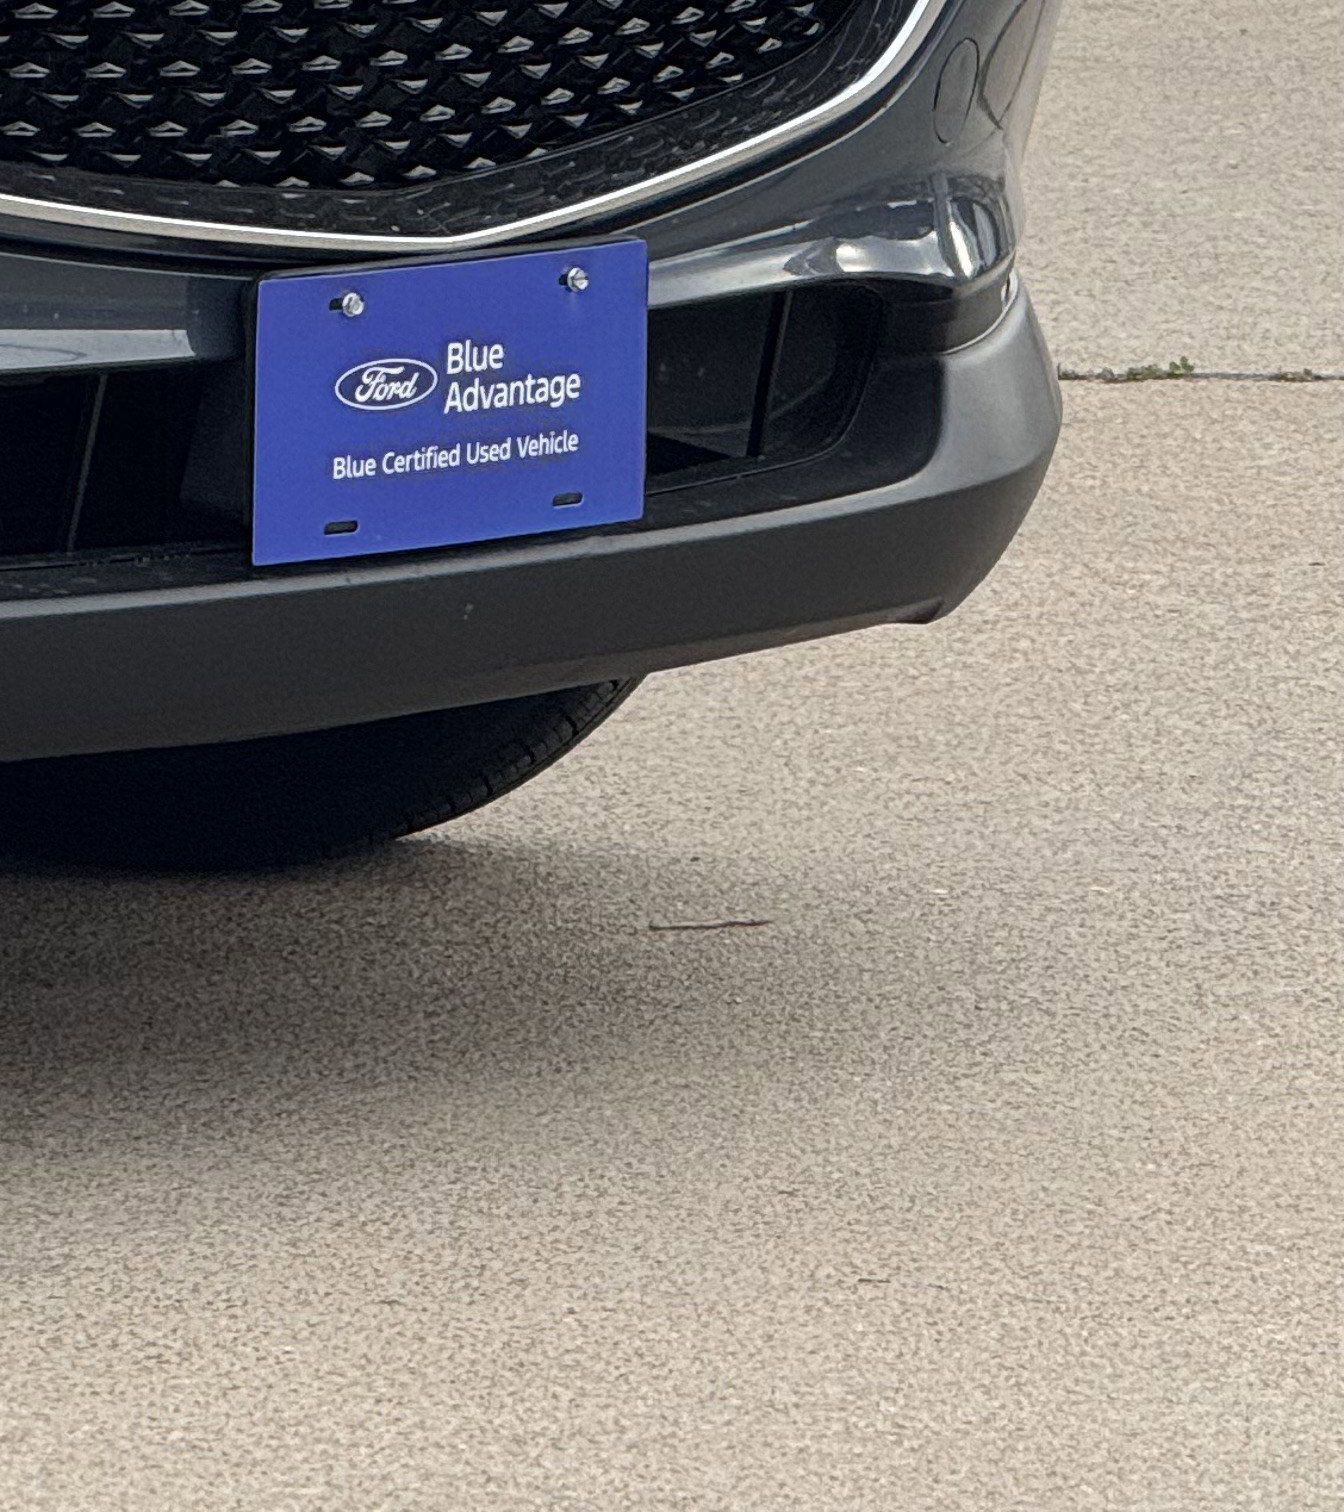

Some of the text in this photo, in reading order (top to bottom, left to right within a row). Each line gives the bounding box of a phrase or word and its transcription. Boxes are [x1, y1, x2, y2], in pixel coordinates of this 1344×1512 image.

[447, 339, 503, 374] Blue
[354, 365, 418, 403] Ford
[443, 373, 581, 414] Advantage
[333, 429, 579, 480] Blue Certified Used Vehicle
